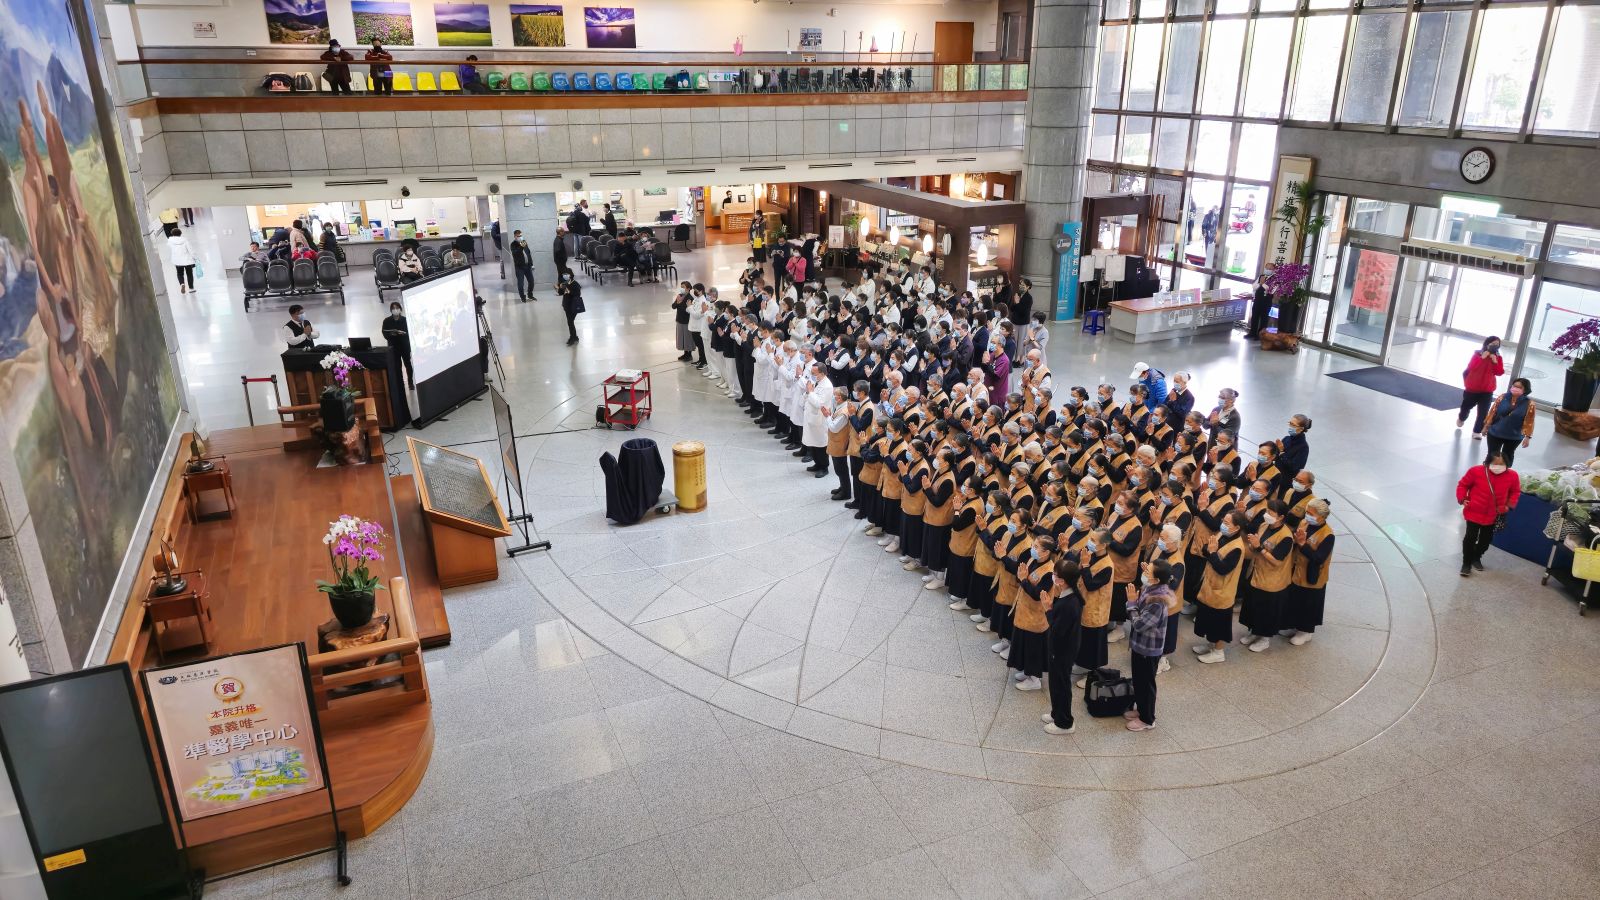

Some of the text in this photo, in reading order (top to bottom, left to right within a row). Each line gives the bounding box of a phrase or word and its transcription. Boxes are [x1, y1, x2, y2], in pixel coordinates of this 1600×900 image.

[210, 703, 257, 719] 本院升格
[208, 717, 268, 736] 嘉義唯一
[183, 723, 299, 760] 準醫學中心
